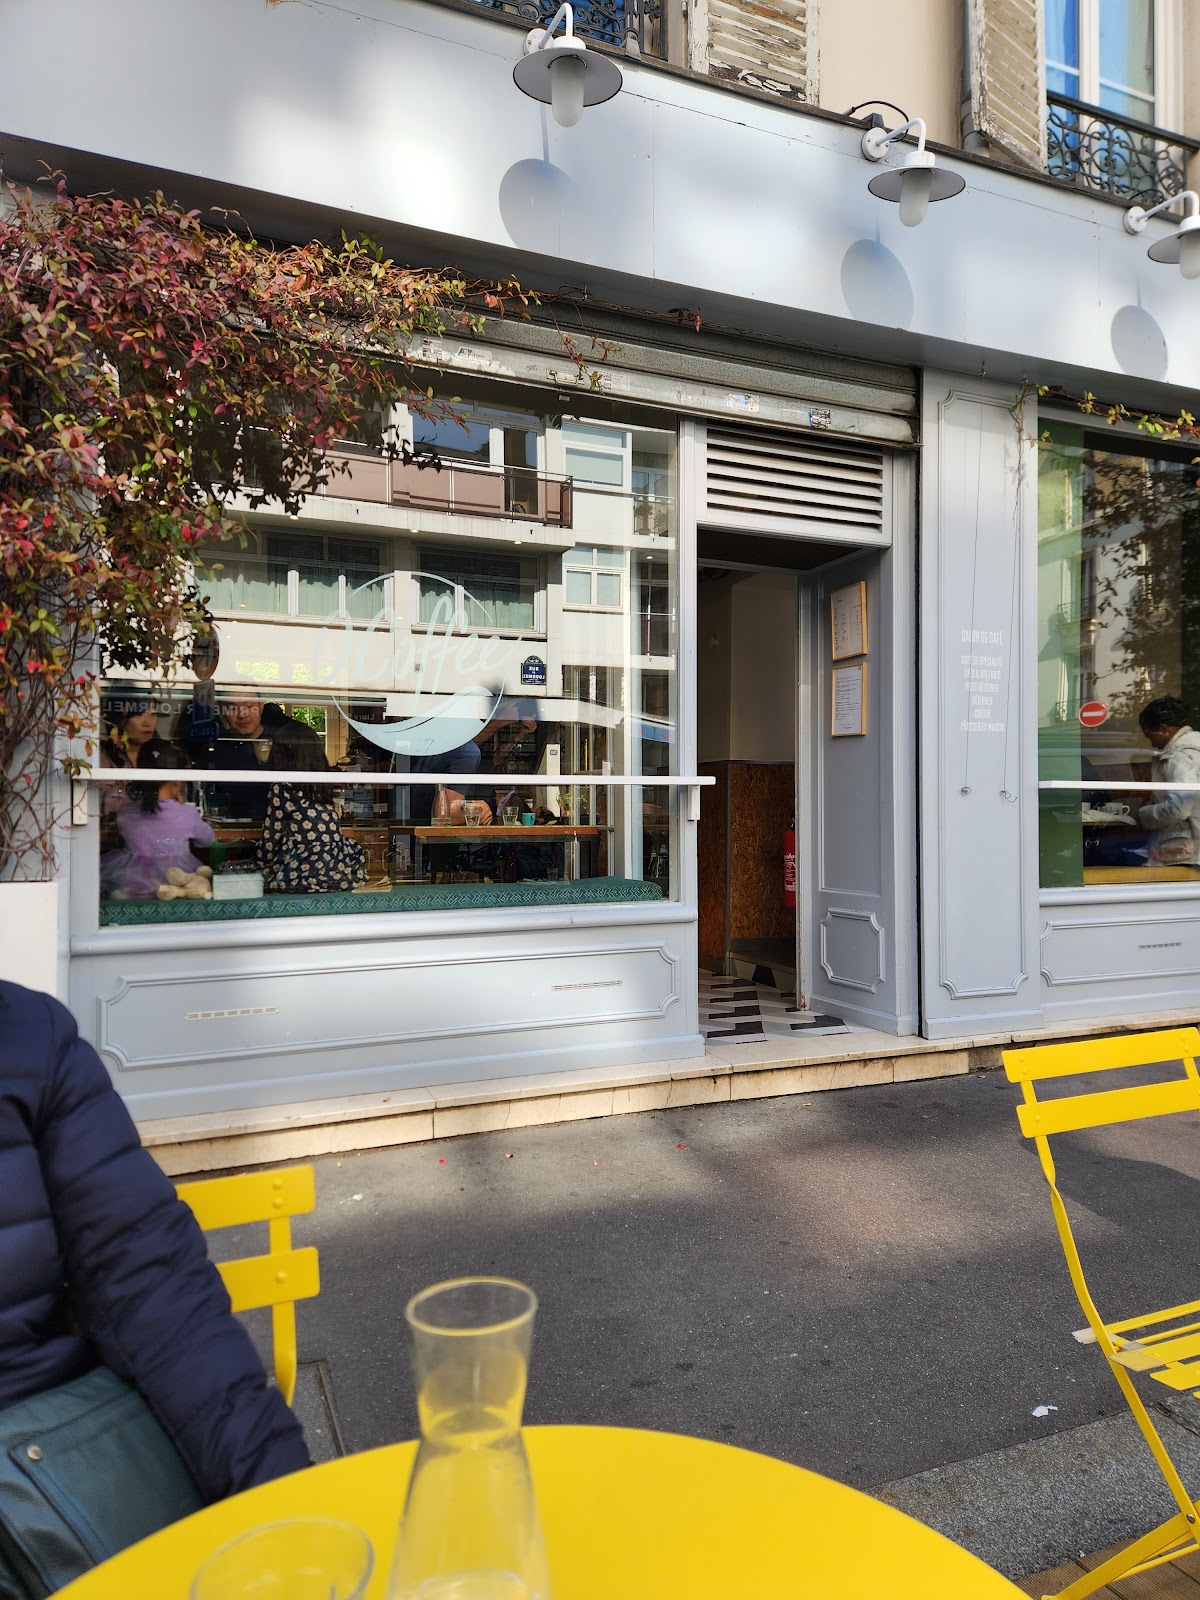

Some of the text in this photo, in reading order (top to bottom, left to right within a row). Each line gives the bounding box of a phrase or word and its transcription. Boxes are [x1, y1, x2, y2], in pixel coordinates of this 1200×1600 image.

[961, 629, 1003, 645] SALON DE CAFÉ
[979, 655, 1003, 667] SPÉCIALITÉ
[987, 722, 1005, 733] MAISON
